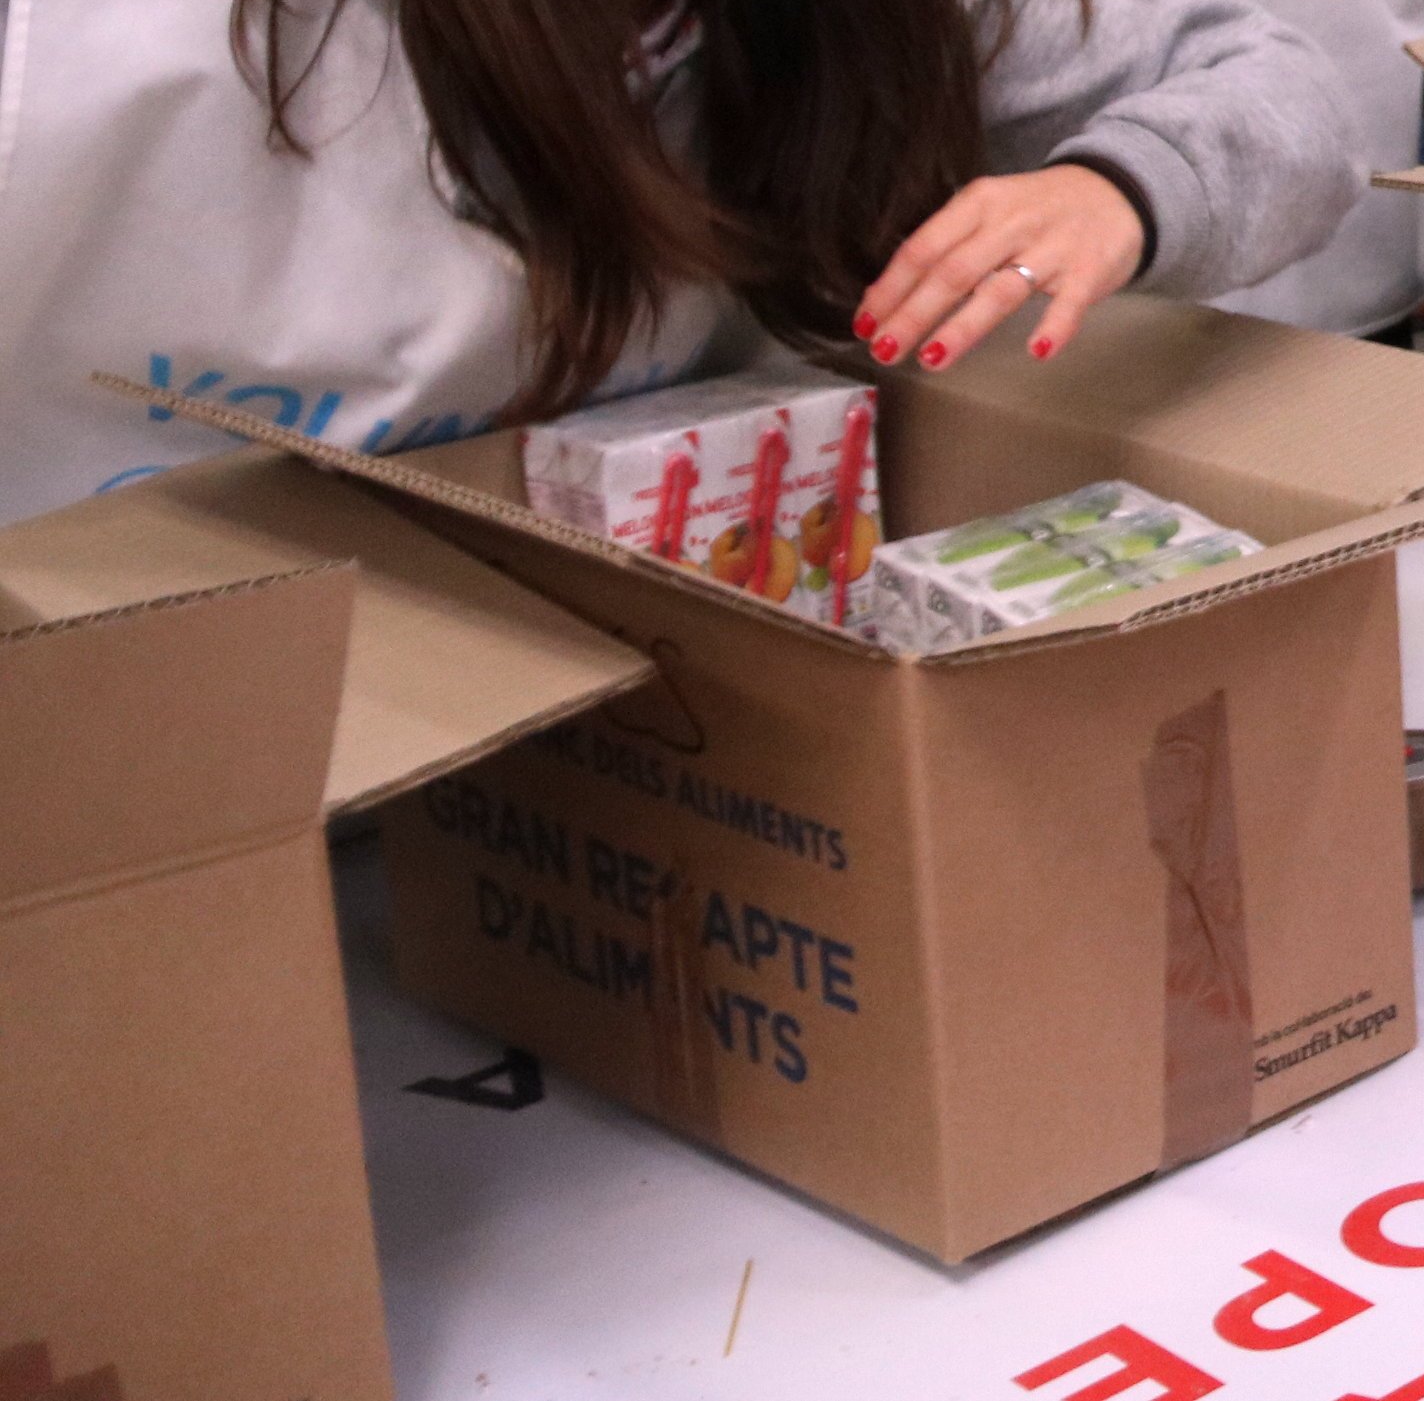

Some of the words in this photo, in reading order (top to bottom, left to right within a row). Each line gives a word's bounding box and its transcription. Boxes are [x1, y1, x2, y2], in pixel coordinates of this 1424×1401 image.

[424, 776, 570, 882] GRAN
[585, 835, 859, 1014] REAPTE
[679, 770, 848, 871] ALIMENTS
[474, 874, 809, 1085] D'ALIMNTS
[1254, 1030, 1333, 1083] Smurfit
[1334, 1003, 1398, 1045] Kappa
